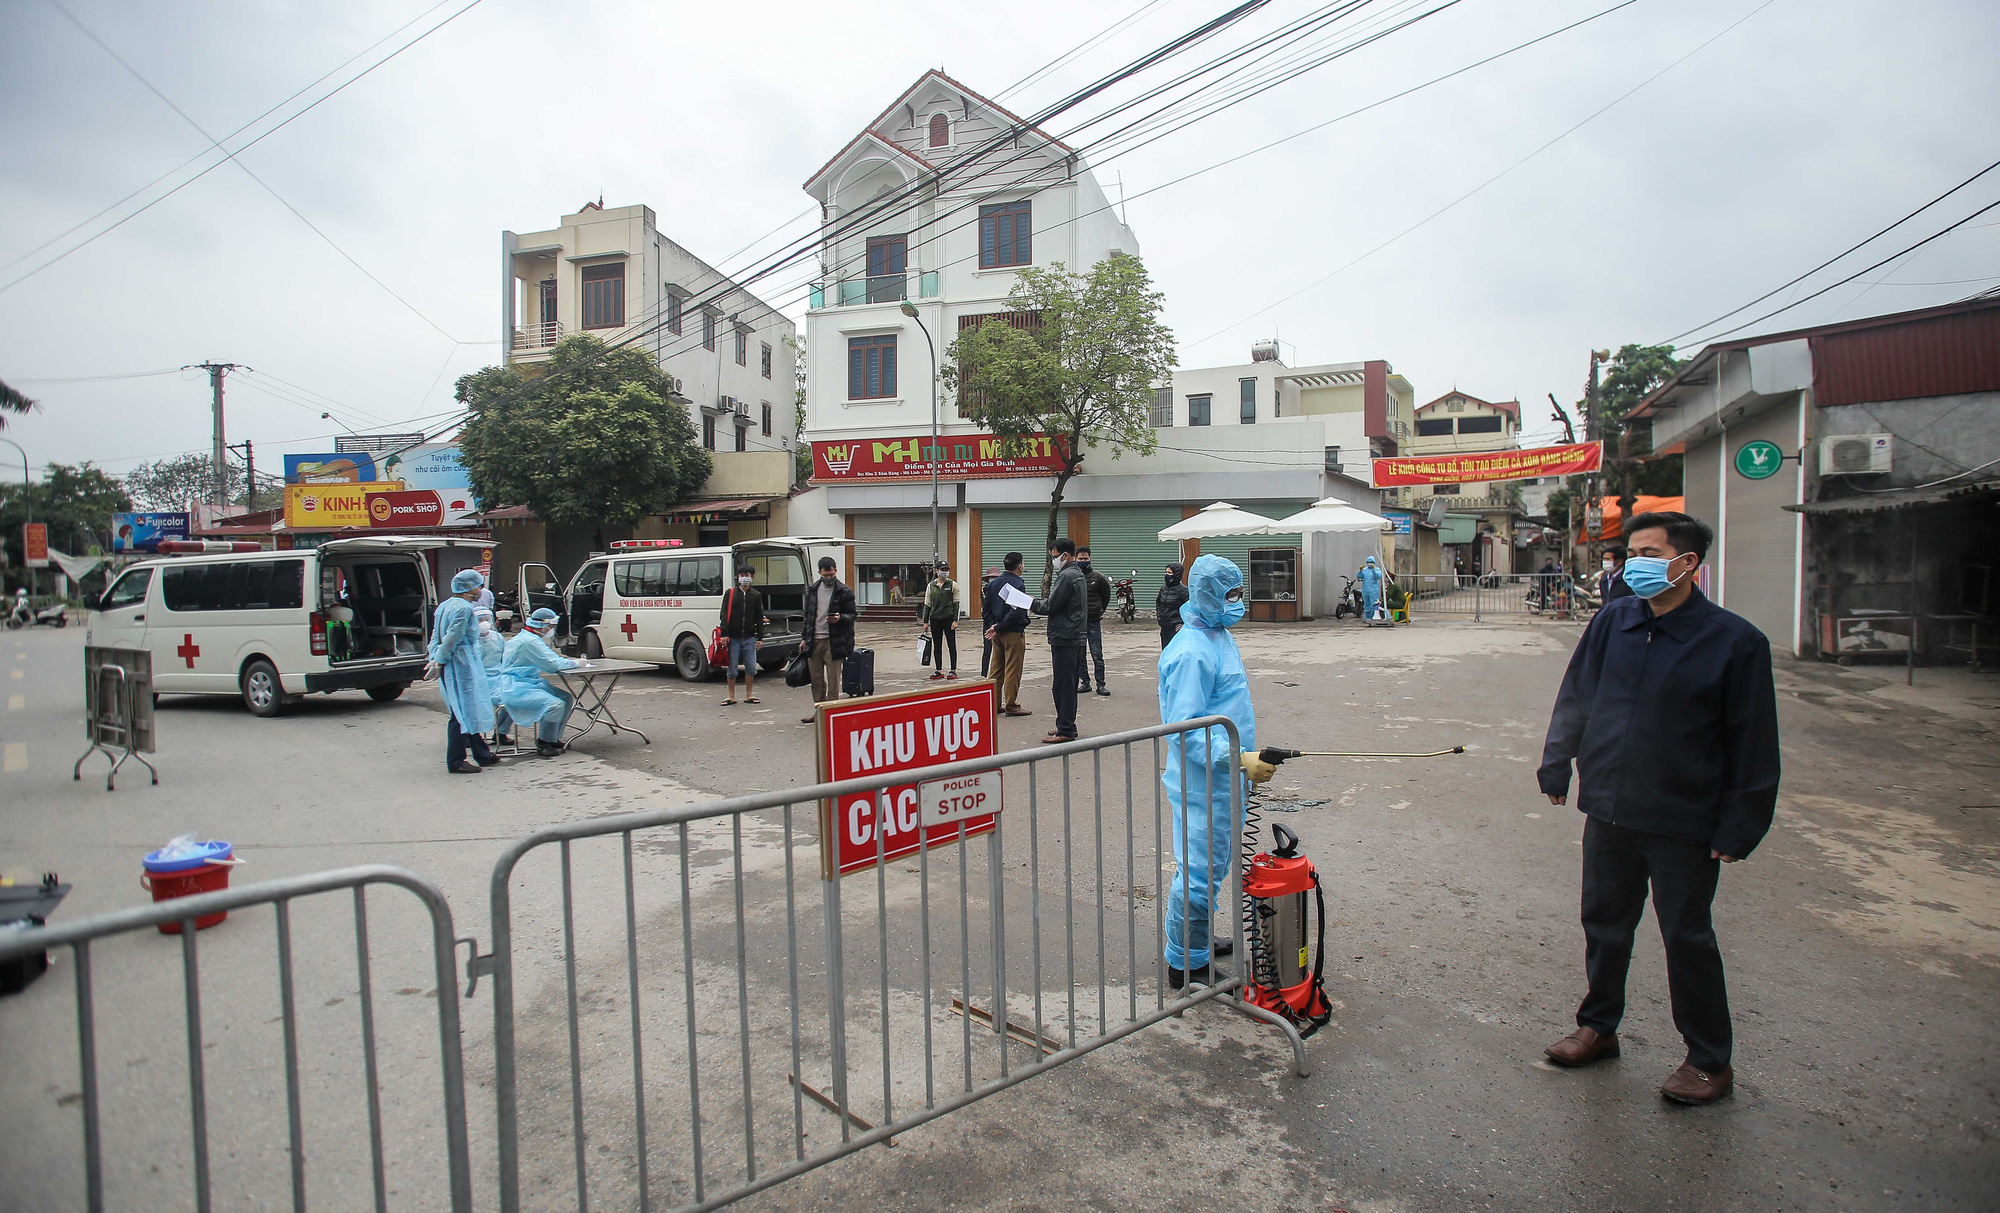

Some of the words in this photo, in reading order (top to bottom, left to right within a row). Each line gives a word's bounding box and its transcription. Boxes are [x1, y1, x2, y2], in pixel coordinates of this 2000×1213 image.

[872, 438, 920, 463] MH
[979, 437, 1052, 459] MRT
[431, 454, 450, 462] Tuyệt
[963, 461, 978, 469] Mọi
[415, 465, 428, 473] như
[430, 464, 440, 473] cái
[442, 464, 452, 472] ôm
[1416, 461, 1436, 474] CÔNG
[1437, 462, 1446, 473] TU
[1460, 459, 1474, 472] TÔN
[1476, 459, 1490, 474] TẠO
[323, 496, 361, 511] KINH
[374, 504, 387, 514] CP
[393, 505, 415, 514] PORK
[416, 505, 438, 513] SHOP
[146, 516, 184, 530] Fujicolor
[849, 720, 916, 773] KHU
[924, 708, 980, 760] VỰC
[943, 777, 980, 792] POLICE
[938, 792, 986, 815] STOP
